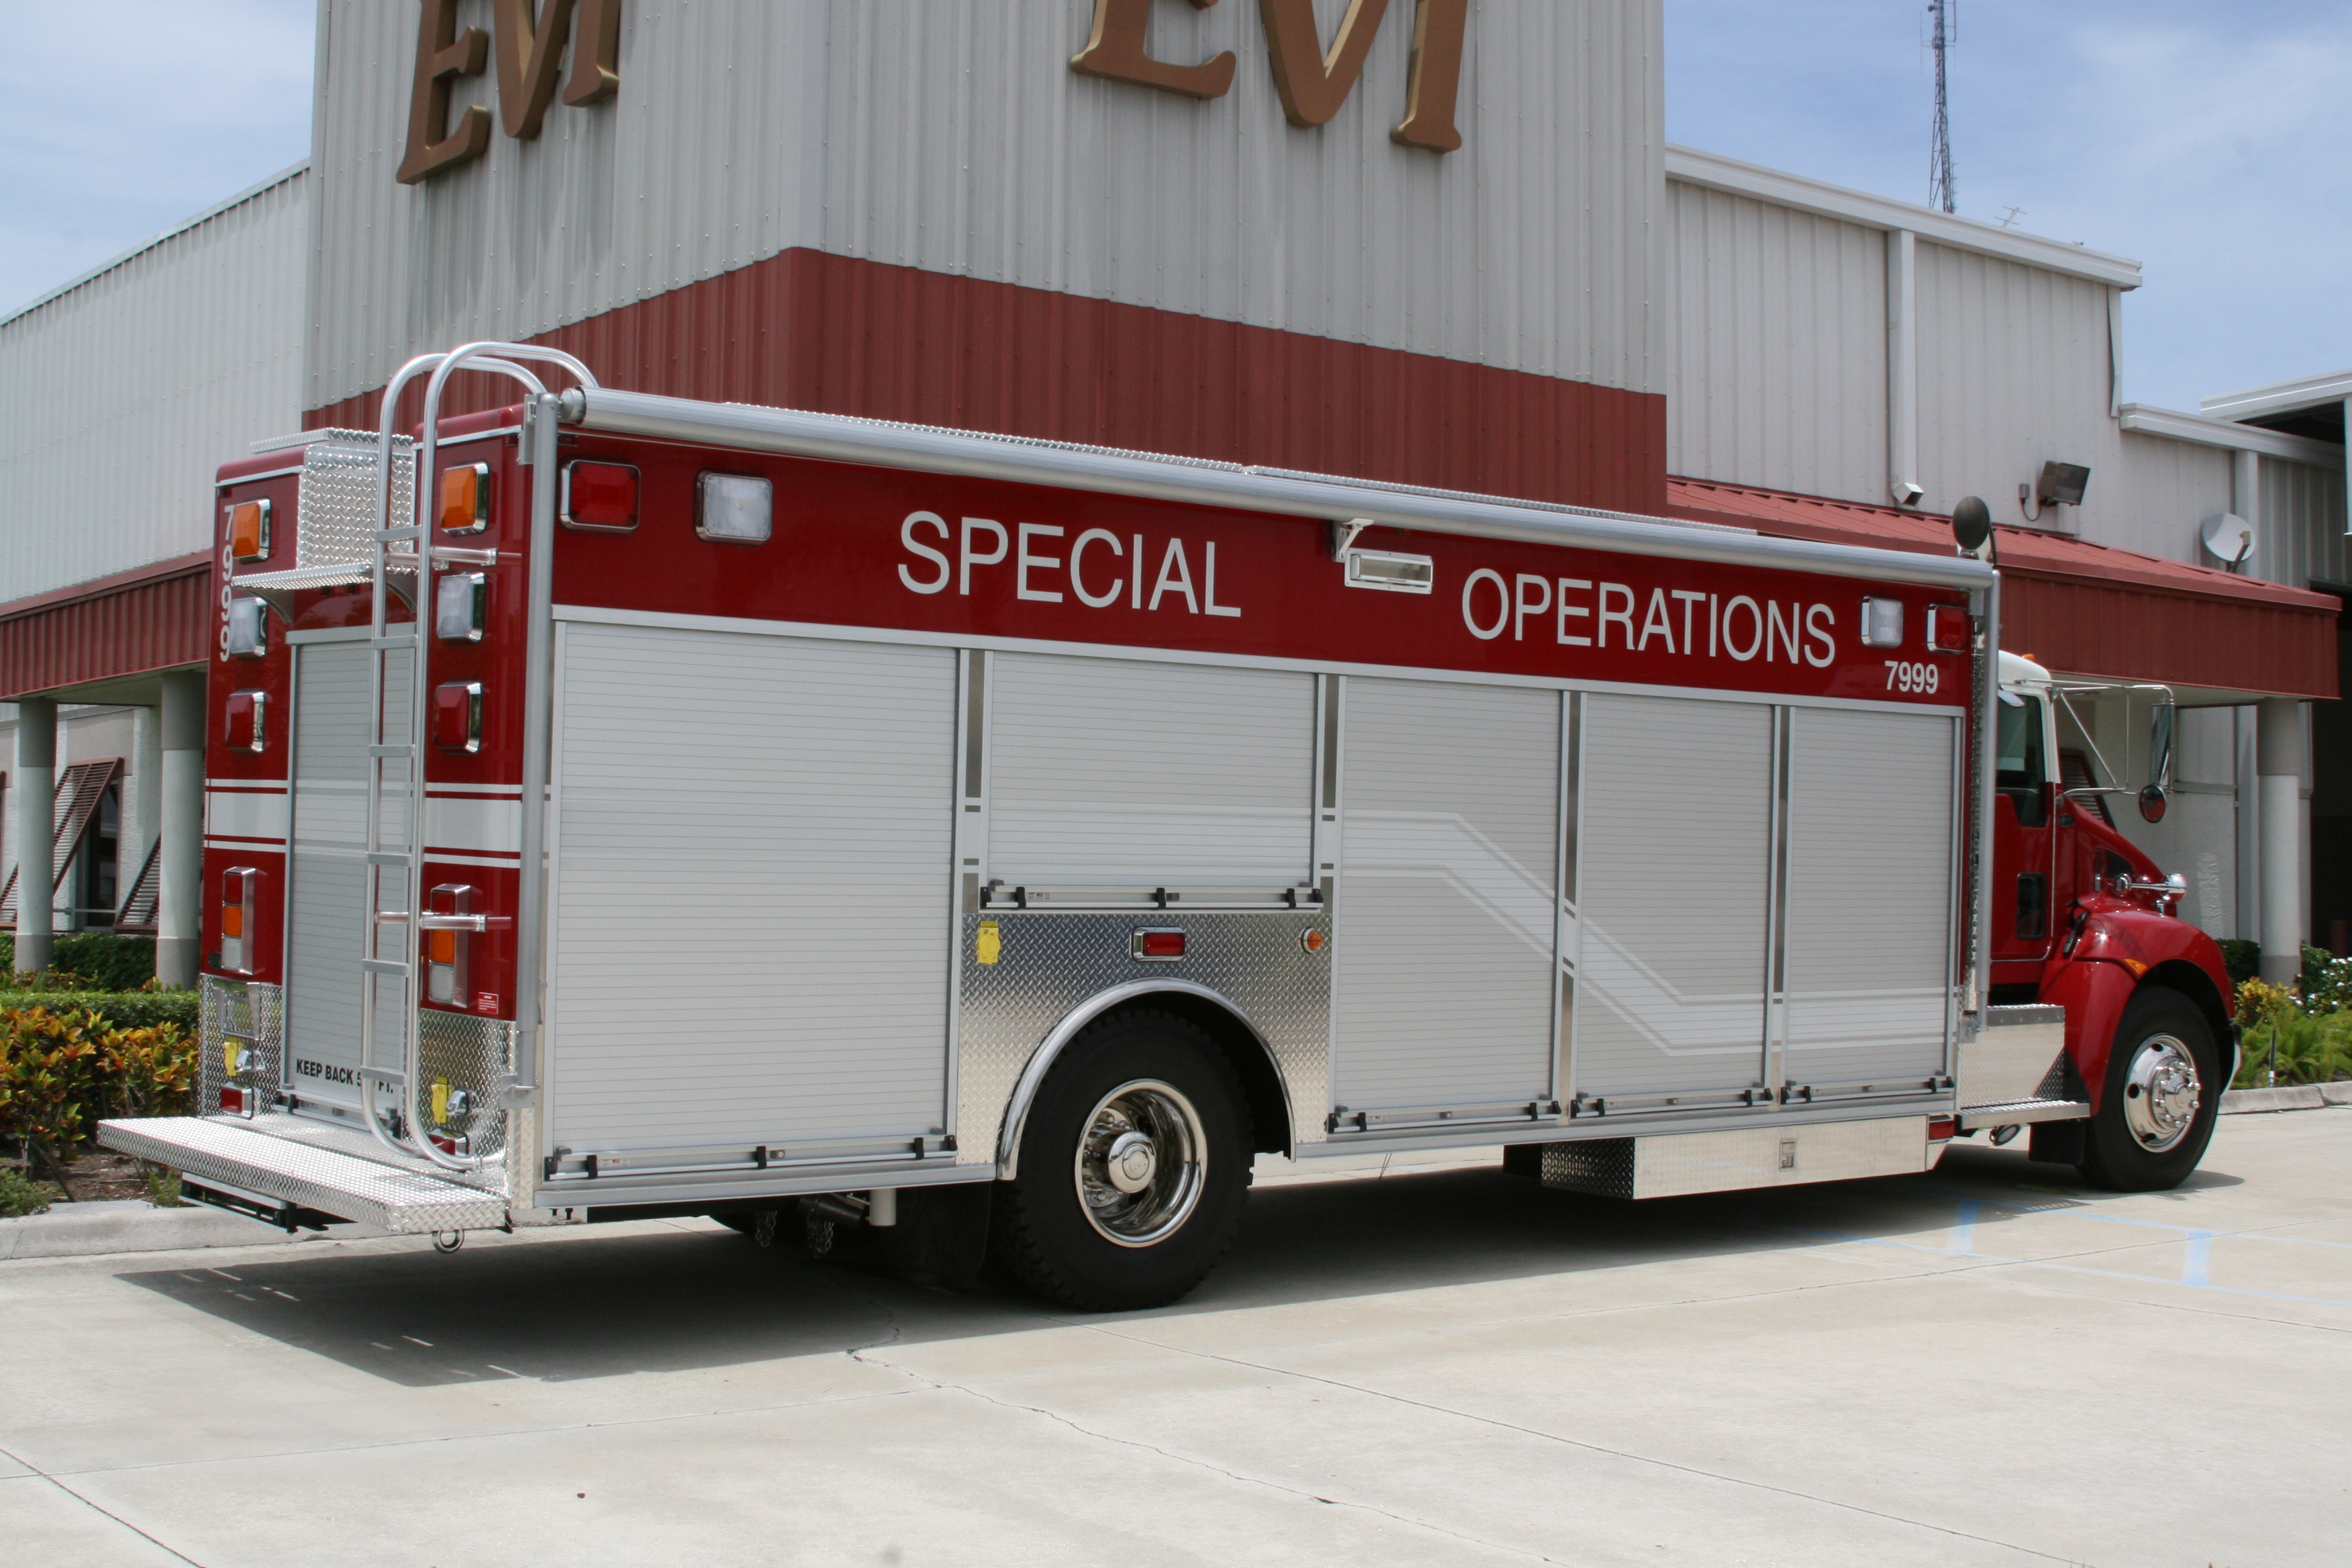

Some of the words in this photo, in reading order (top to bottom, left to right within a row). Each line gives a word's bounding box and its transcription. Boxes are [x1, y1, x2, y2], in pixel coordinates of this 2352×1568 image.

[897, 510, 1242, 618] SPECIAL
[1461, 568, 1836, 668] OPERATIONS
[1884, 660, 1939, 694] 7999
[296, 1059, 322, 1077] KEEP
[325, 1065, 354, 1085] BACK
